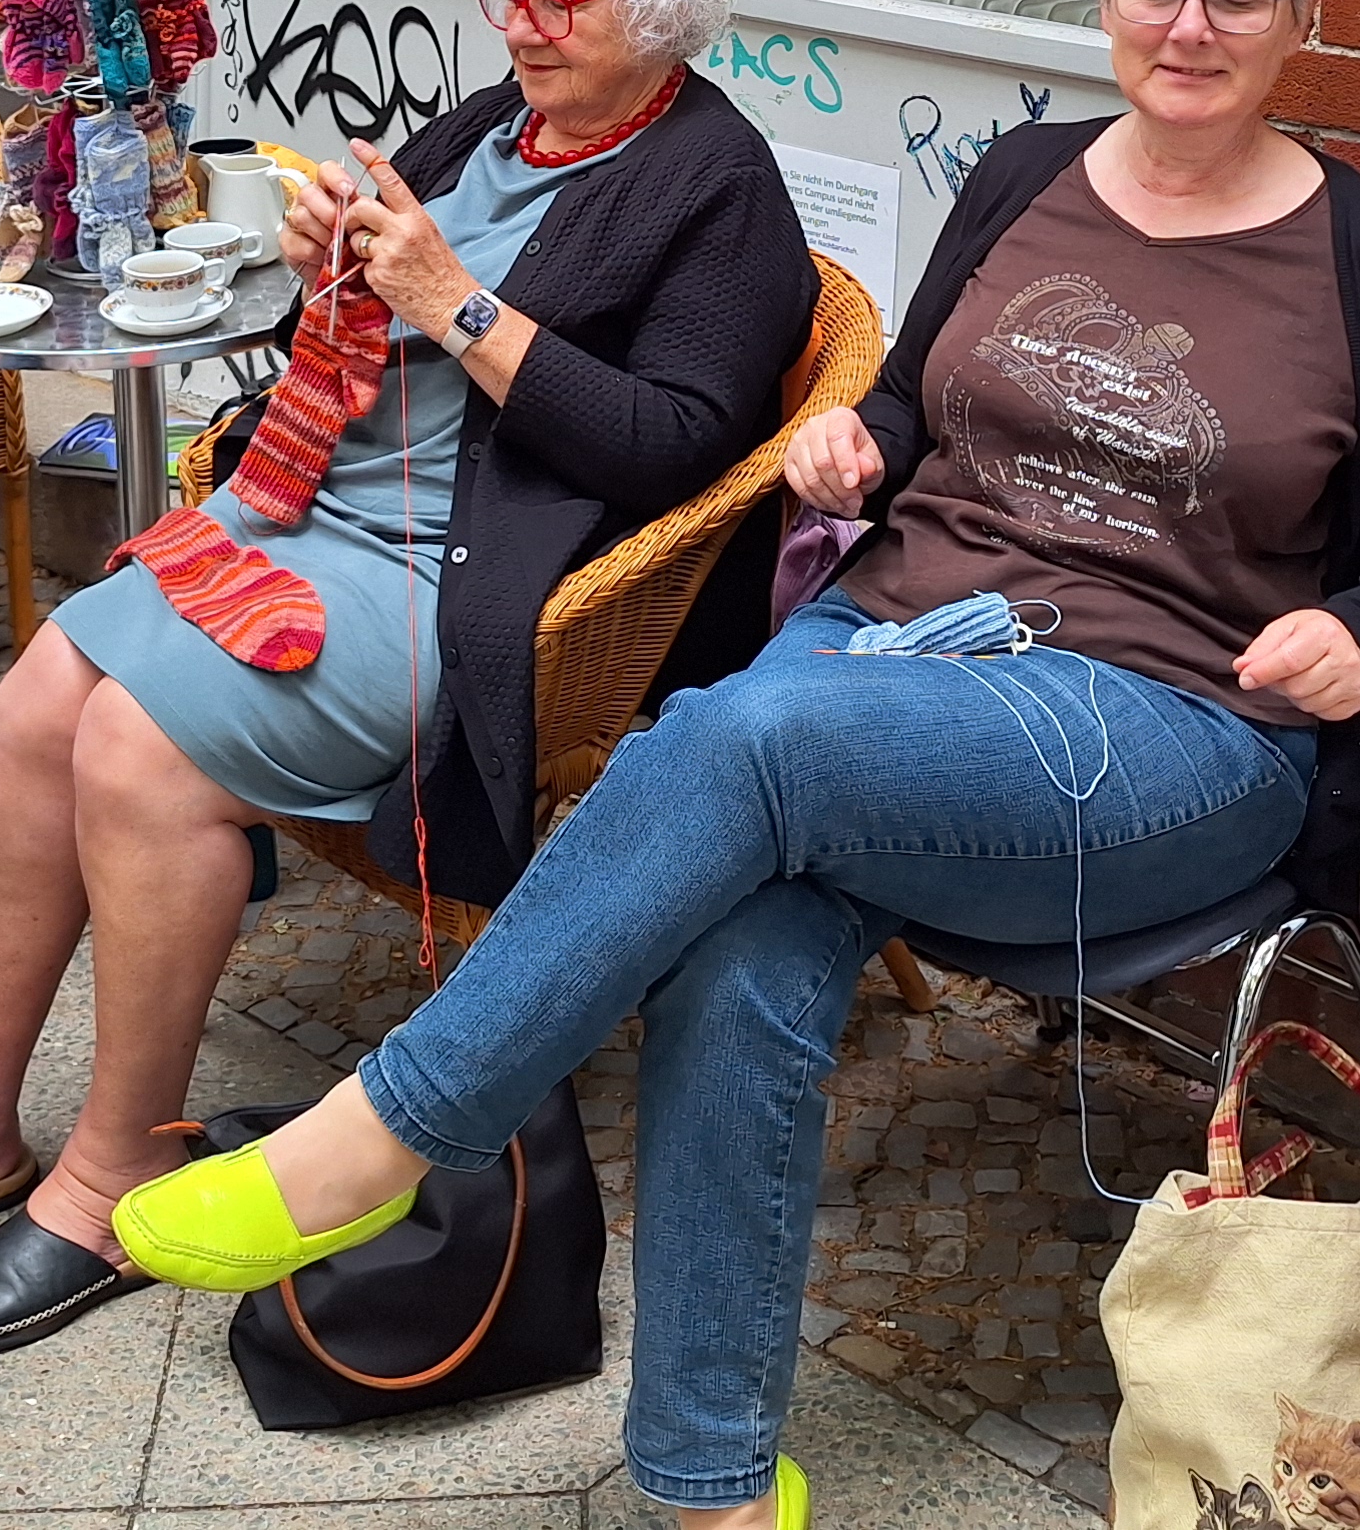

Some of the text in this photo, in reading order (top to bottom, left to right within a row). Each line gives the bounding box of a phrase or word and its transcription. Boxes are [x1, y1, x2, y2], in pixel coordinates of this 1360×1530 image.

[789, 170, 879, 200] Sie nicht im Durchgang
[804, 187, 875, 211] Campus und nicht
[810, 202, 877, 226] der umliegenden
[1011, 334, 1057, 356] Time
[1018, 453, 1063, 475] follows
[1066, 470, 1100, 486] after
[1104, 480, 1126, 496] the
